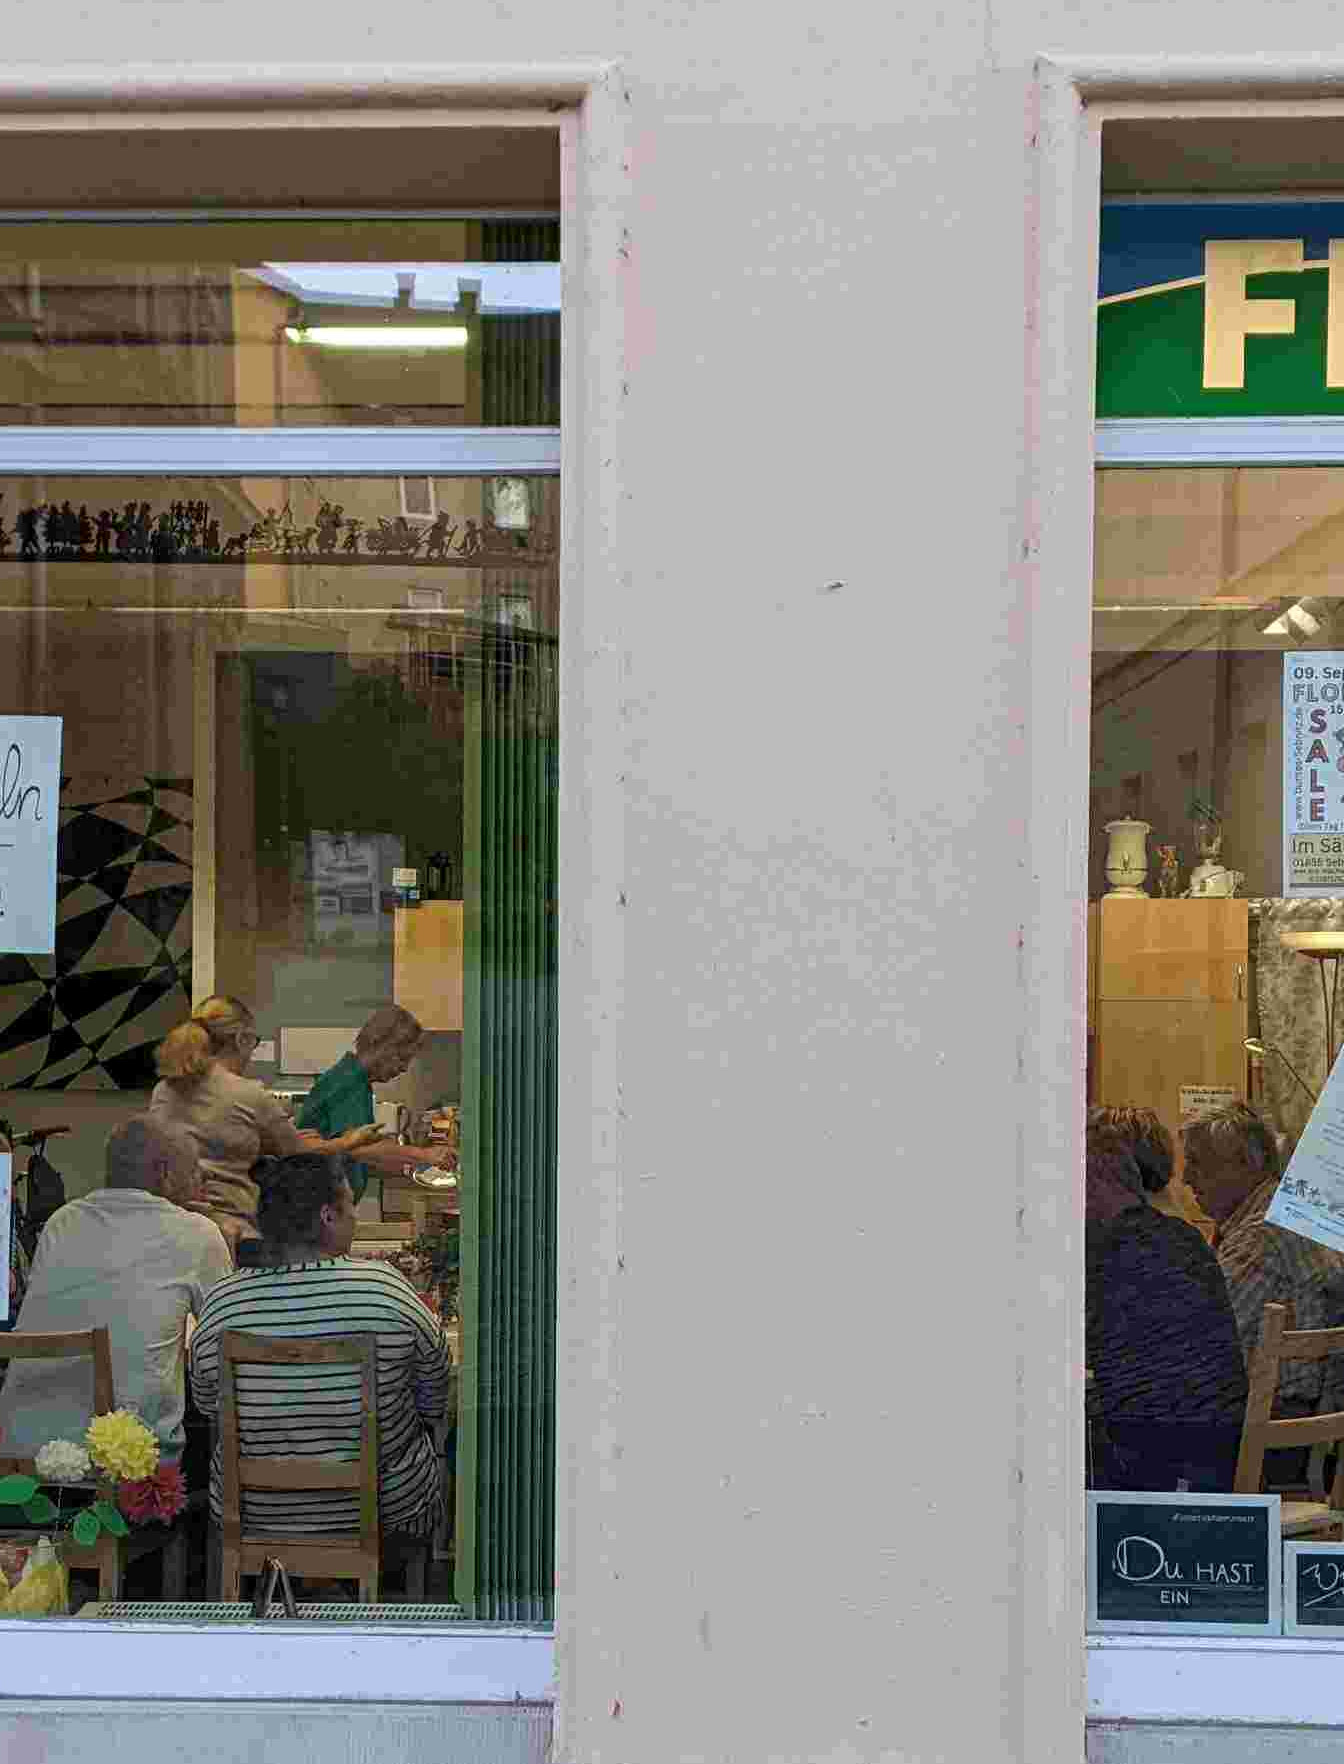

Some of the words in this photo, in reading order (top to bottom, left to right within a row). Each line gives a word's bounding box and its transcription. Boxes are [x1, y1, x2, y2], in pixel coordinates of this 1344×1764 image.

[1294, 666, 1319, 680] 09.
[1291, 837, 1315, 853] Im
[1112, 1535, 1184, 1581] Du
[1197, 1562, 1255, 1585] HAST
[1159, 1589, 1191, 1605] EIN
